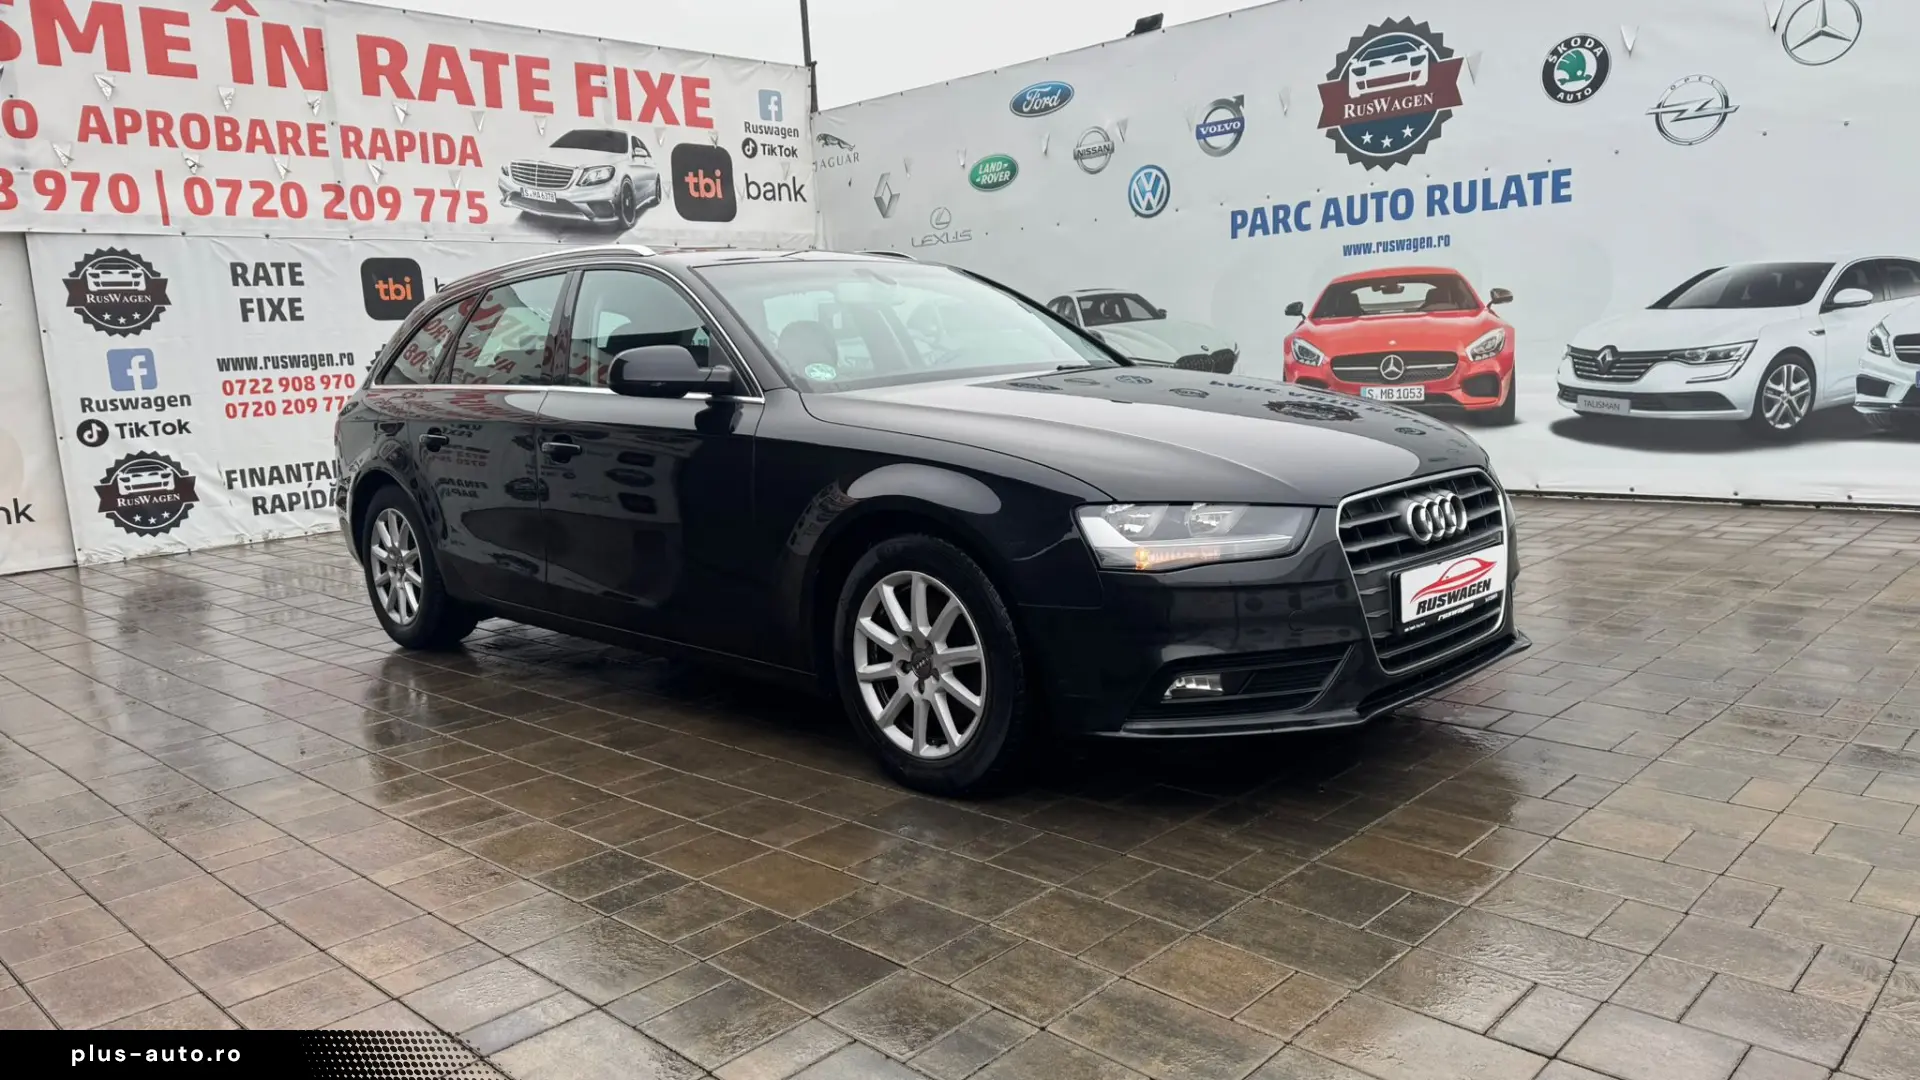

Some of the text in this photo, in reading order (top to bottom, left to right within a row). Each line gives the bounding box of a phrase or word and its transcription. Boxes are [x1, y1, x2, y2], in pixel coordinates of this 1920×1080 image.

[211, 0, 328, 91] ÎN
[356, 34, 554, 115] RATE
[574, 61, 714, 129] FIXE
[1022, 86, 1062, 112] Ford
[1557, 87, 1592, 102] AUTO
[77, 105, 329, 158] APROBARE
[340, 125, 483, 168] RAPIDA
[744, 121, 799, 140] Ruswagen
[1200, 121, 1241, 135] VOLVO
[760, 143, 798, 159] TikTok
[1077, 143, 1111, 157] NISSAN
[813, 152, 860, 173] JAGUAR
[978, 161, 1002, 174] LAND
[684, 169, 808, 203] tbi bank
[980, 170, 1010, 185] ROVER
[33, 169, 140, 214] 970
[183, 176, 308, 219] 0720
[321, 183, 401, 221] 209
[413, 188, 488, 225] 775
[1230, 168, 1573, 239] PARC AUTO RULATE
[911, 229, 973, 248] LEXUS
[1342, 234, 1451, 257] www.ruswagen.ro
[229, 262, 305, 287] RATE
[375, 276, 412, 301] tbi
[239, 297, 305, 323] FIXE
[217, 352, 355, 373] www.ruswagen.ro
[222, 373, 355, 397] 0722 908 970
[80, 394, 192, 413] Ruswagen
[225, 395, 352, 419] 0720 209 77
[114, 419, 192, 439] TikTok
[1416, 578, 1492, 616] RUSWAGEN
